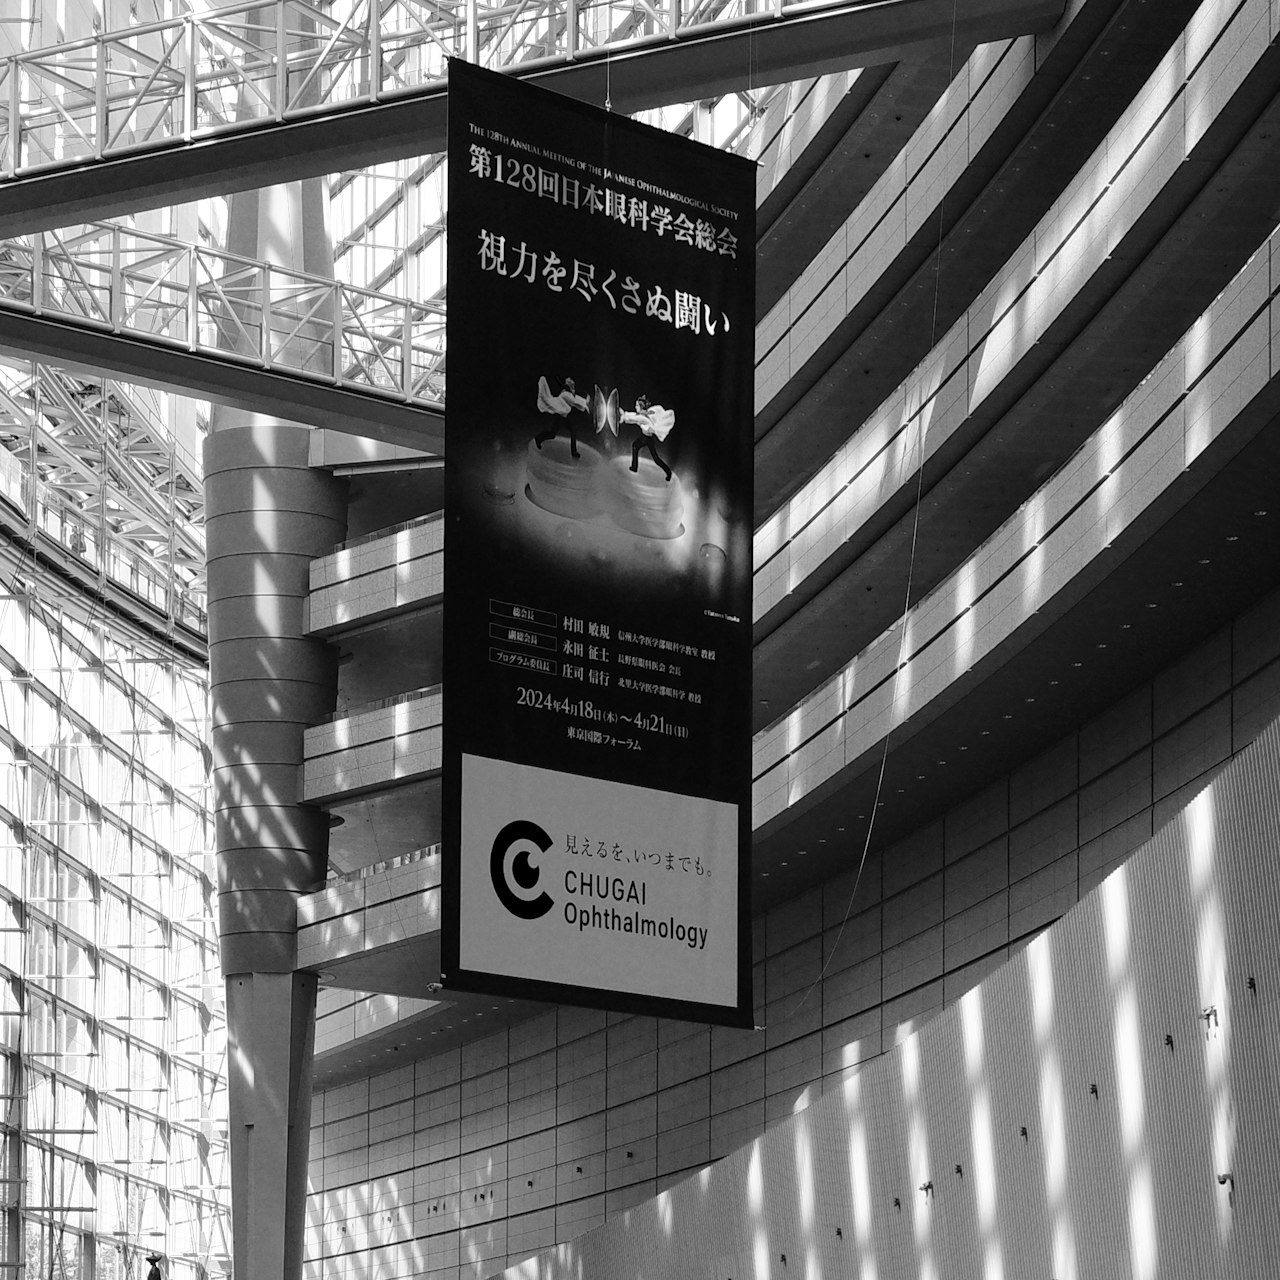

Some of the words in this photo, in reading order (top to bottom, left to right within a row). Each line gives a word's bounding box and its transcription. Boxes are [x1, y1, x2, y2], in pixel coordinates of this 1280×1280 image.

[468, 122, 484, 136] THE
[510, 138, 540, 155] ANNUAL
[542, 149, 575, 167] MEETING
[576, 160, 587, 170] OF
[588, 163, 602, 176] THE
[710, 203, 739, 220] SOCIETY
[468, 143, 738, 260] 第128回日本眼科学会総会
[477, 228, 731, 337] 視力を尽くさぬ闘い
[563, 616, 584, 634] 村田
[588, 669, 610, 687] 信行
[567, 726, 642, 751] 東京国際フォーラム
[564, 833, 712, 878] 見えるを、いつまでも。
[564, 870, 646, 905] CHUGAI
[564, 902, 708, 950] Ophthalmology
